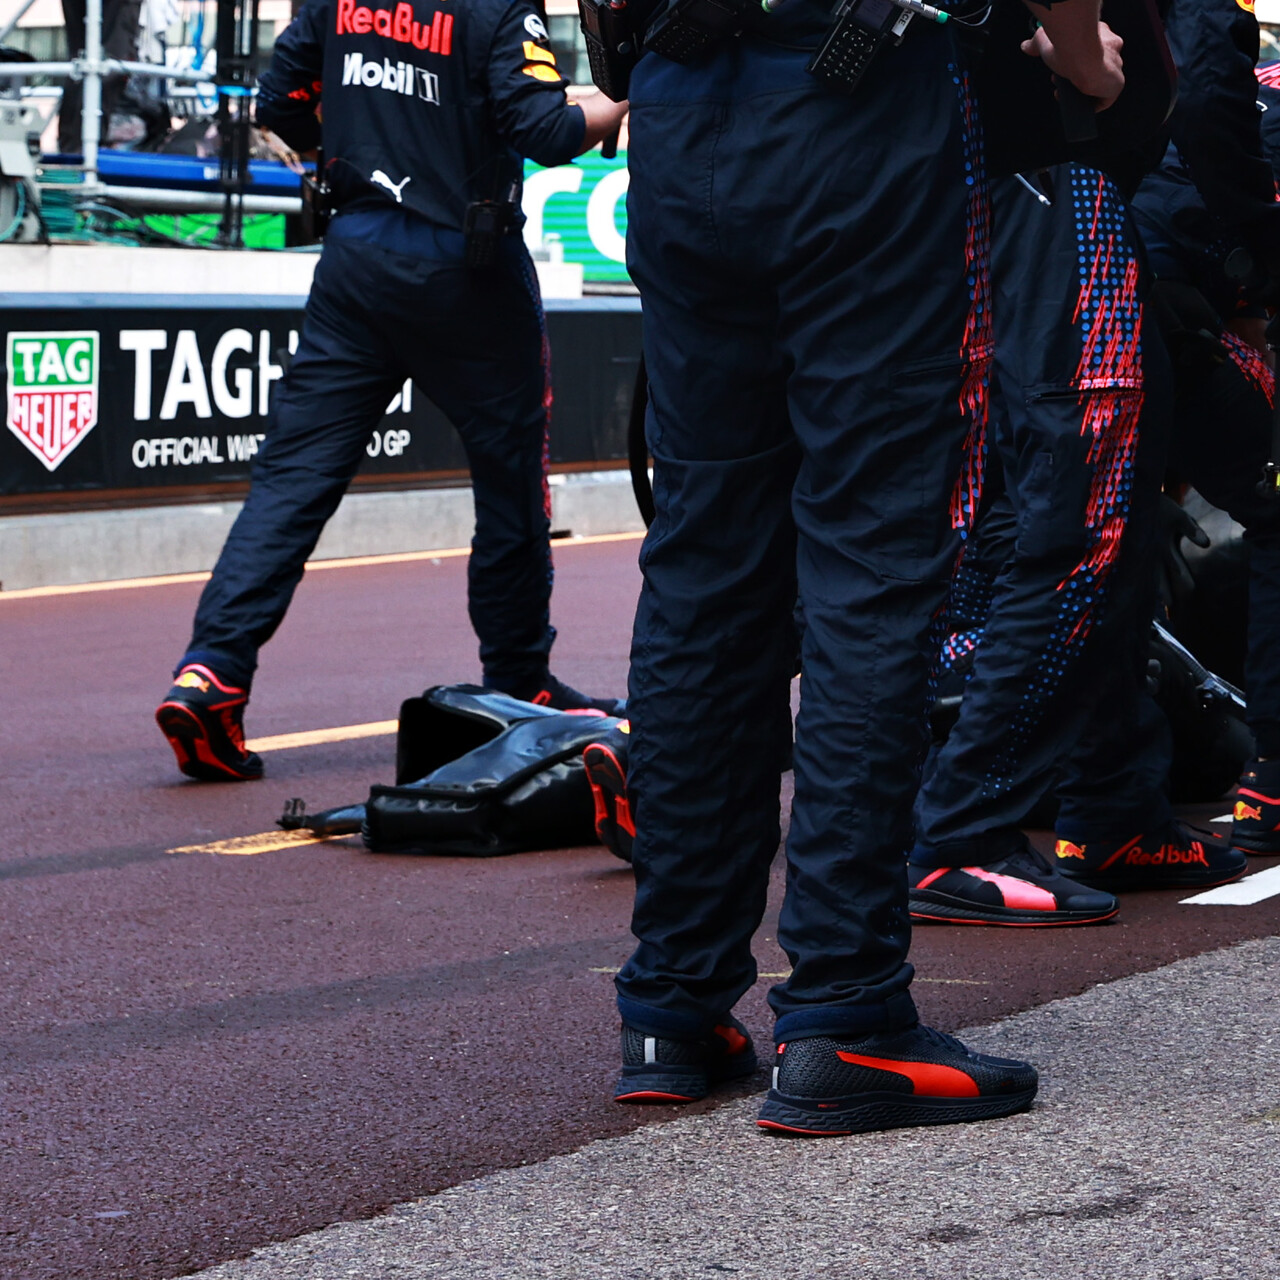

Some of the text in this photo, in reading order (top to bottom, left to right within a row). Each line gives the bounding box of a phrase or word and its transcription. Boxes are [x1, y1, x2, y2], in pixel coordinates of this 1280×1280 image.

[392, 1, 454, 56] Bull
[15, 340, 90, 383] TAG
[13, 392, 92, 458] HEUER
[131, 434, 223, 468] OFFICIAL
[383, 429, 411, 457] GP
[1125, 846, 1165, 865] Red
